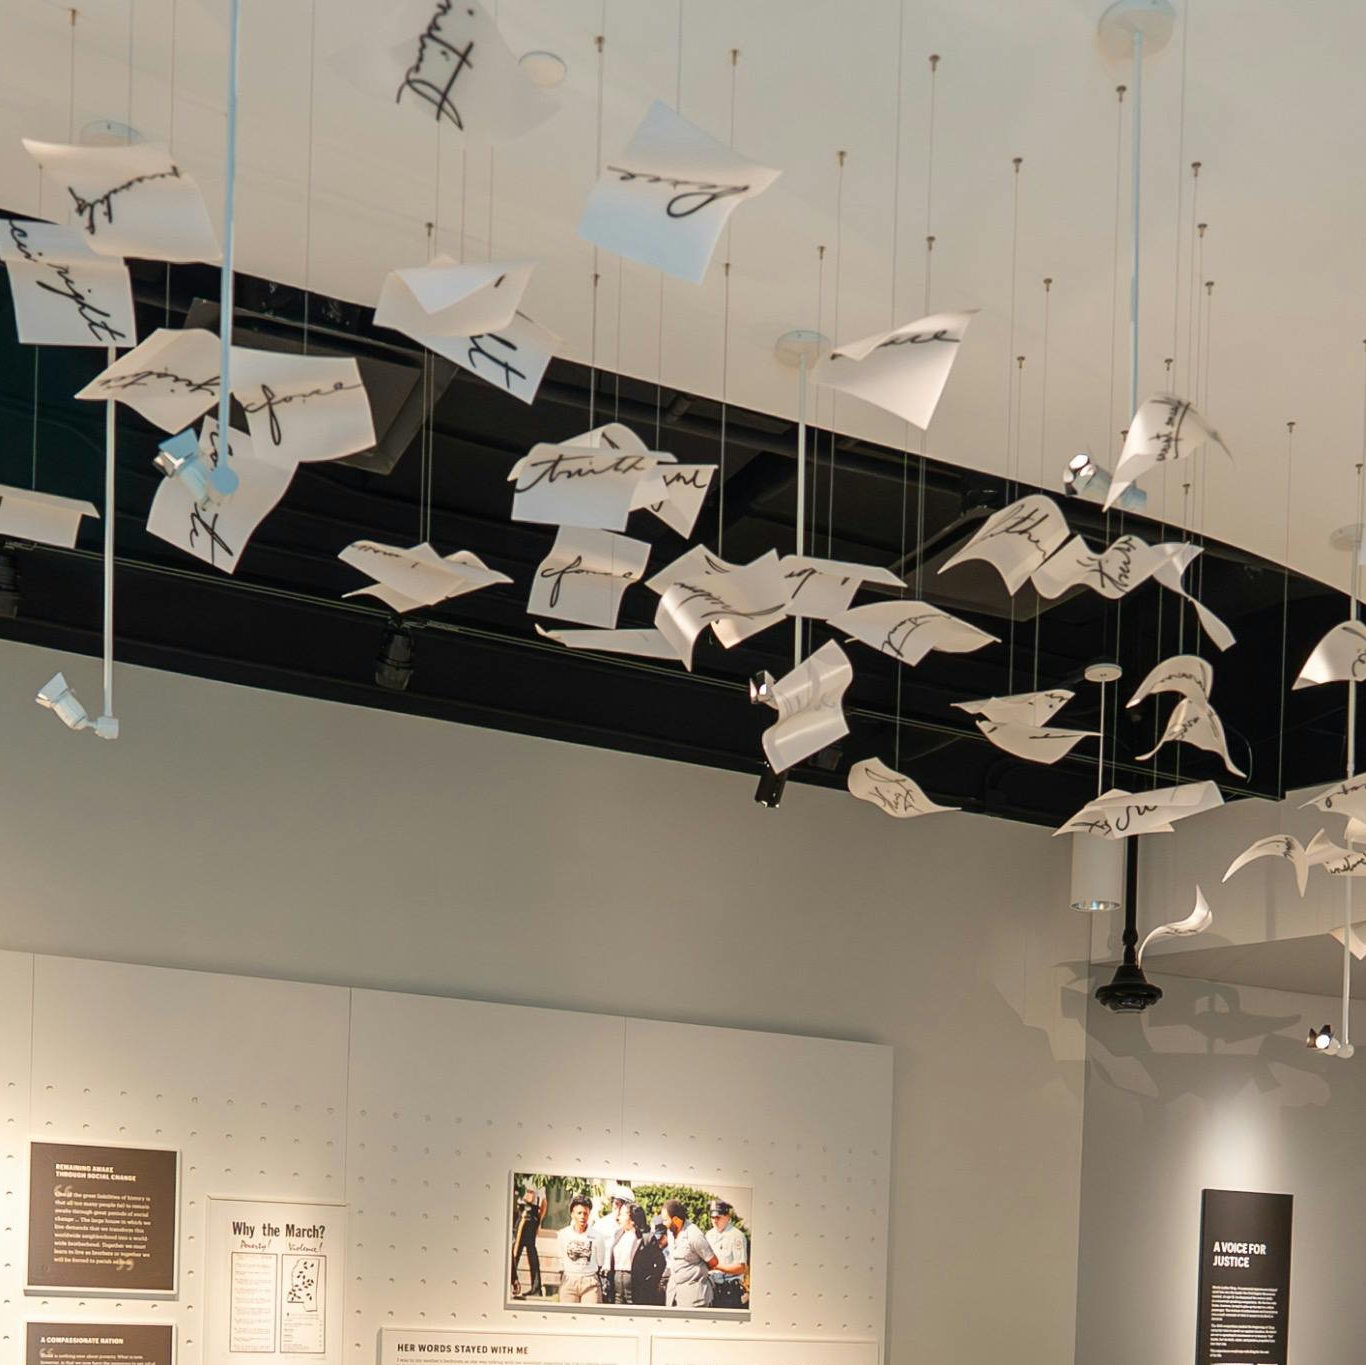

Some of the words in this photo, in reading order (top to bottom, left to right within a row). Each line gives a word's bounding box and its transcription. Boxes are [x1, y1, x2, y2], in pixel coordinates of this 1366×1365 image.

[55, 1163, 91, 1172] REMAINING
[55, 1171, 87, 1179] THROUGH
[111, 1174, 137, 1182] CHANGE
[232, 1221, 255, 1239] Why
[262, 1223, 280, 1237] the
[285, 1224, 326, 1239] March?
[1213, 1241, 1220, 1253] A
[1221, 1242, 1248, 1254] VOICE
[1249, 1243, 1267, 1255] FOR
[1213, 1256, 1250, 1268] JUSTICE
[397, 1343, 416, 1353] HER
[418, 1344, 452, 1354] WORDS
[454, 1345, 488, 1354] STAYED
[490, 1346, 513, 1355] WITH
[516, 1346, 529, 1355] ME
